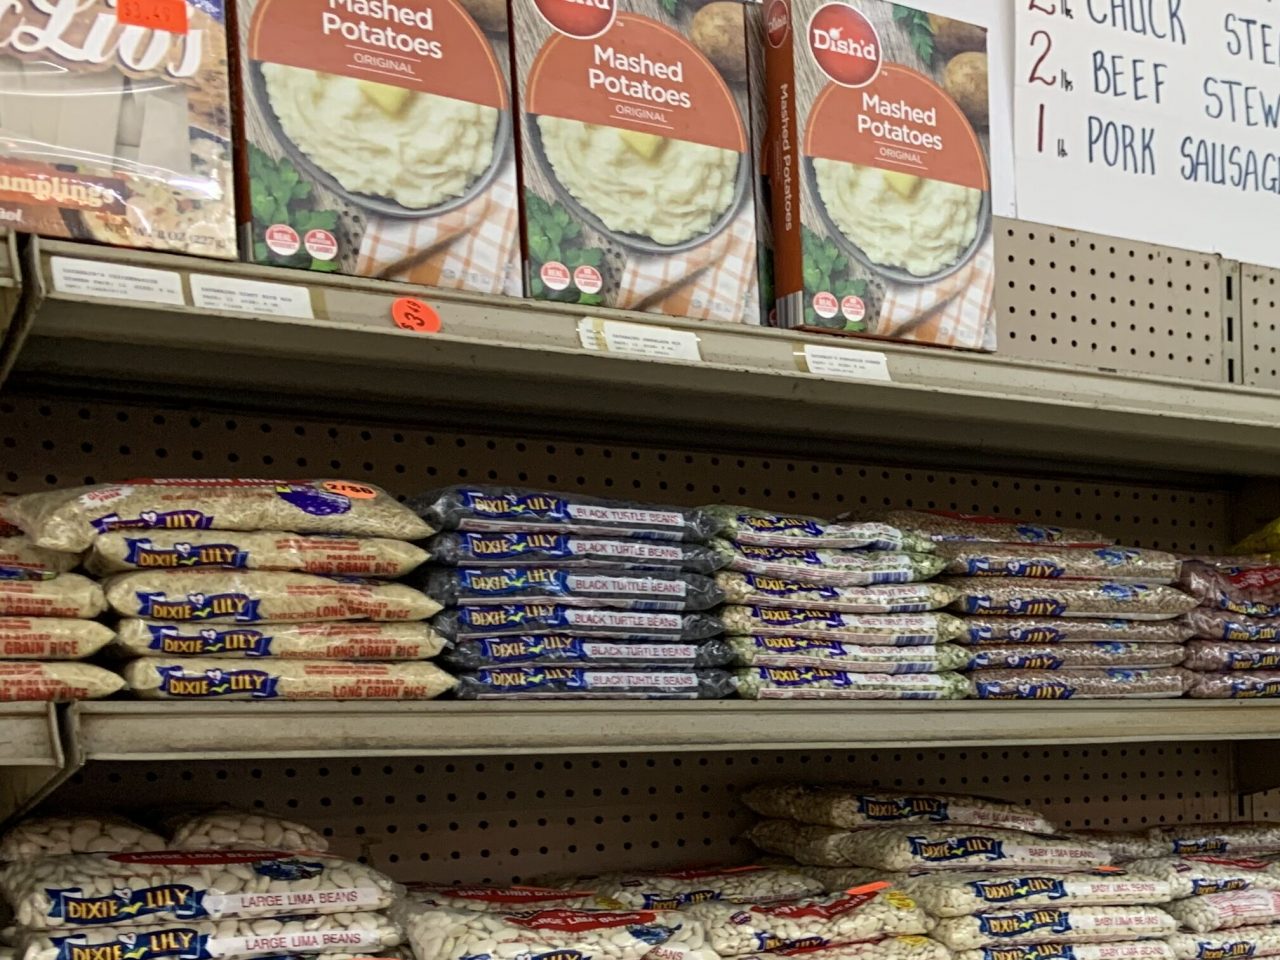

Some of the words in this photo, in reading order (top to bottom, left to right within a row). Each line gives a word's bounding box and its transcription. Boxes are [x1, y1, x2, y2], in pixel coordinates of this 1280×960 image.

[328, 0, 434, 30] Mashed
[322, 12, 442, 58] Potatoes
[813, 27, 876, 62] Dish'd
[354, 51, 416, 75] ORIGINAL
[594, 45, 683, 82] Mashed
[1029, 31, 1056, 85] 2
[1093, 51, 1168, 103] BEEF
[589, 70, 691, 109] Potatoes
[615, 104, 667, 123] ORIGINAL
[779, 83, 790, 146] Mashed
[862, 93, 936, 127] Mashed
[857, 115, 942, 151] Potatoes
[1038, 104, 1044, 152] 1
[1088, 116, 1155, 174] PORK
[879, 146, 922, 165] ORIGINAL
[781, 151, 792, 231] Potatoes
[140, 554, 178, 566] DIXIE
[200, 550, 235, 563] LILY
[472, 539, 509, 554] DIXIE
[527, 534, 557, 548] LILY
[576, 542, 608, 554] BLACK
[610, 544, 646, 556] TURTLE
[649, 547, 679, 558] BEANS
[164, 640, 203, 652] DIXIE
[225, 635, 259, 648] LILY
[326, 646, 355, 656] LONG
[359, 646, 391, 656] GRAIN
[396, 646, 419, 656] RICE
[170, 681, 208, 694] DIXIE
[231, 676, 264, 689] LILY
[333, 686, 363, 697] LONG
[366, 687, 398, 697] GRAIN
[403, 687, 427, 697] RICE
[68, 900, 118, 919] DIXIE
[147, 888, 189, 907] LILY
[241, 893, 284, 908] LARGE
[287, 892, 315, 904] LIMA
[319, 890, 358, 903] BEANS
